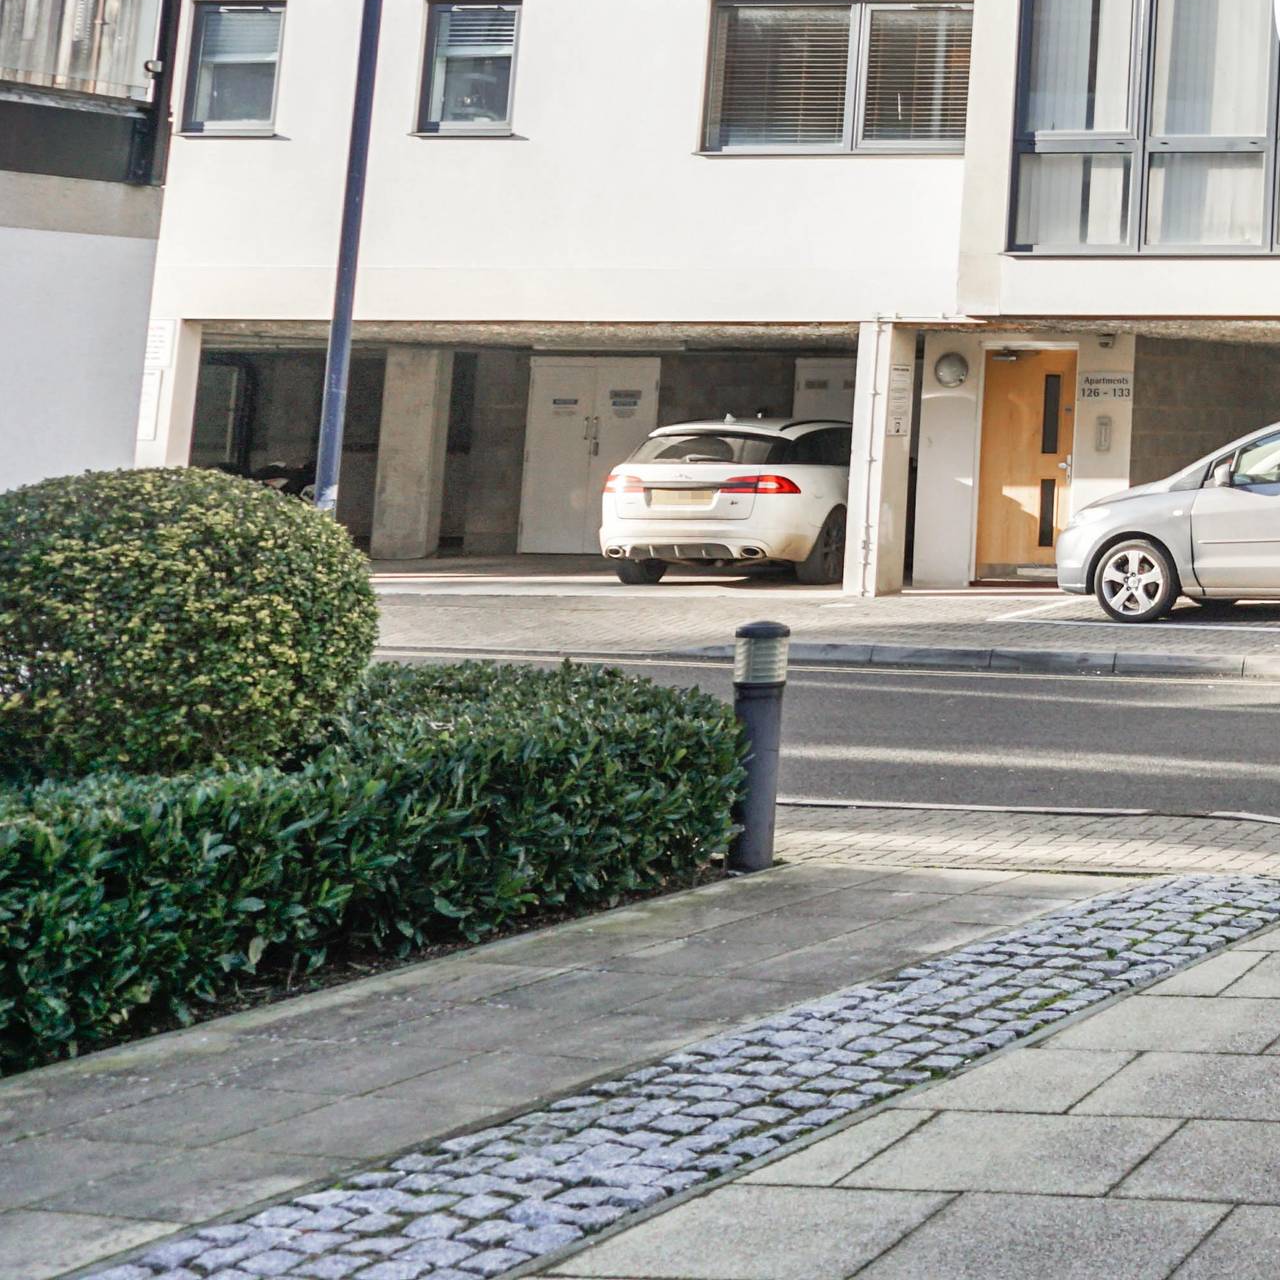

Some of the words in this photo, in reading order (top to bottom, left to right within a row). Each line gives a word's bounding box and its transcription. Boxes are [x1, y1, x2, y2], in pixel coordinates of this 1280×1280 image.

[1084, 376, 1129, 385] Apartments
[1081, 388, 1100, 397] 126
[1113, 388, 1130, 397] 133
